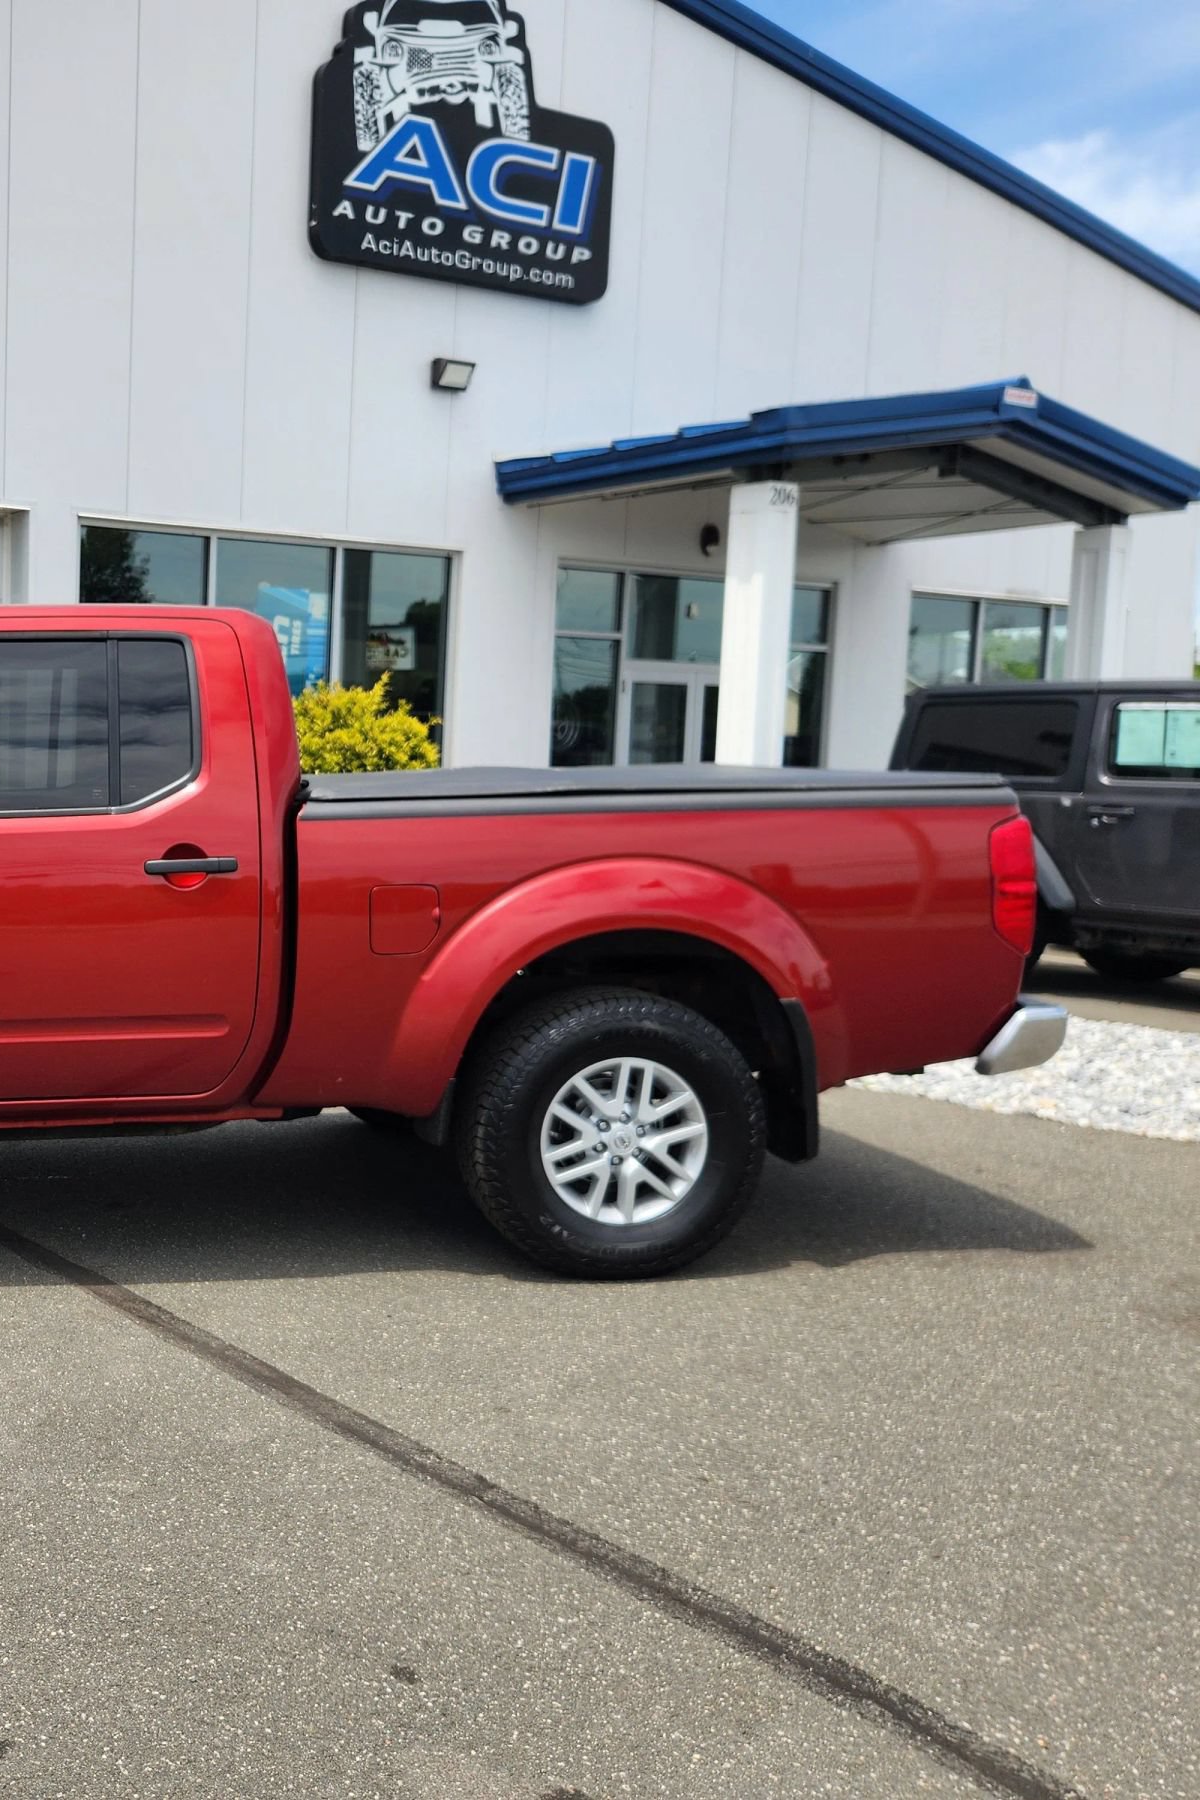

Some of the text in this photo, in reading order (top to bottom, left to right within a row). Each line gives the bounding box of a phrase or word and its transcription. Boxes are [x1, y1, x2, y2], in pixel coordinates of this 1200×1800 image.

[342, 112, 597, 235] ACI
[332, 200, 593, 264] AUTO GROUP
[360, 232, 576, 290] AciAutoGroup.com
